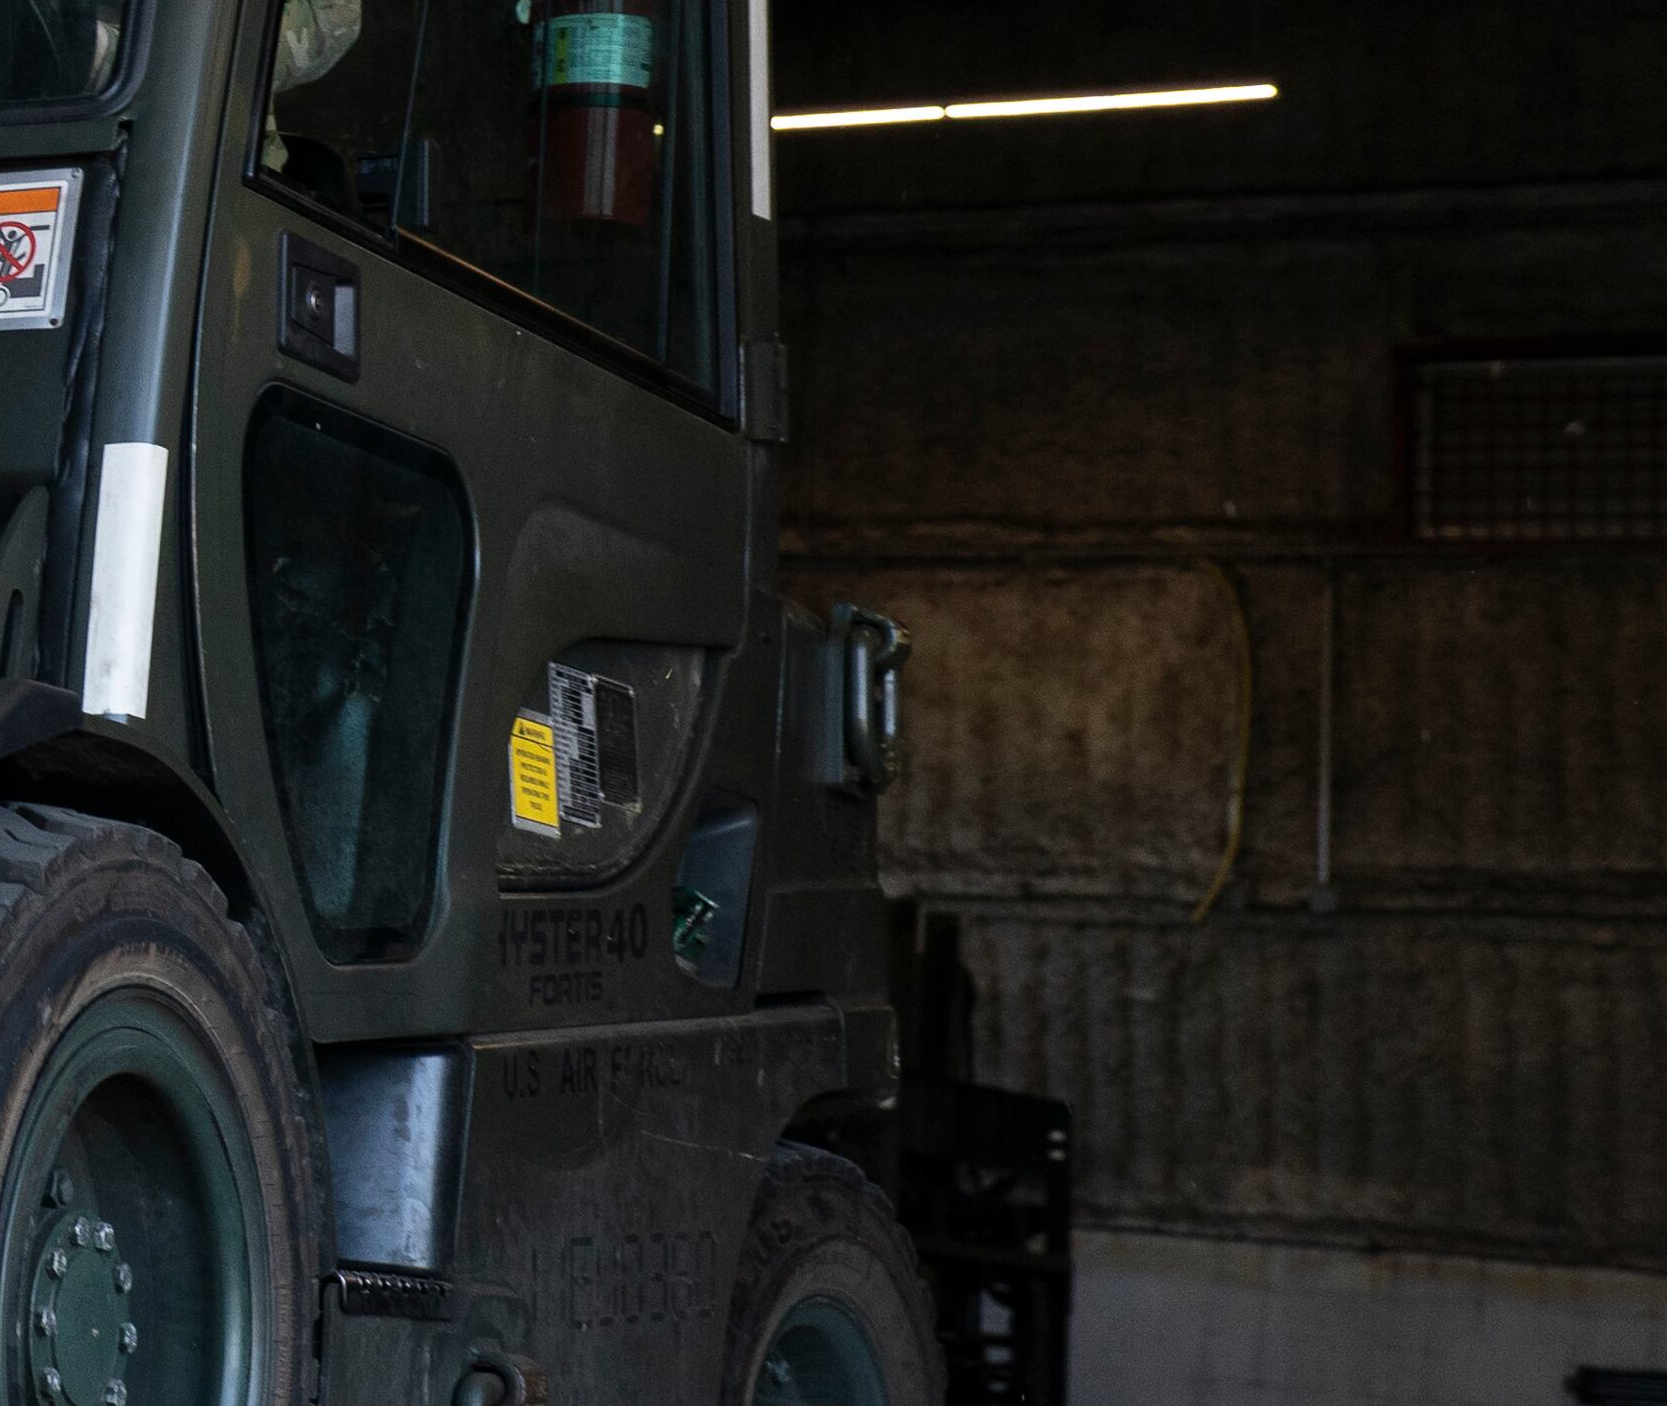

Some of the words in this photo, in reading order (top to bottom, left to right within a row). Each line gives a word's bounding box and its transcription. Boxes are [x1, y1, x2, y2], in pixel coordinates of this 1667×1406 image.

[608, 903, 649, 963] 40
[528, 971, 604, 1007] FORTIS
[560, 1046, 598, 1095] AIR
